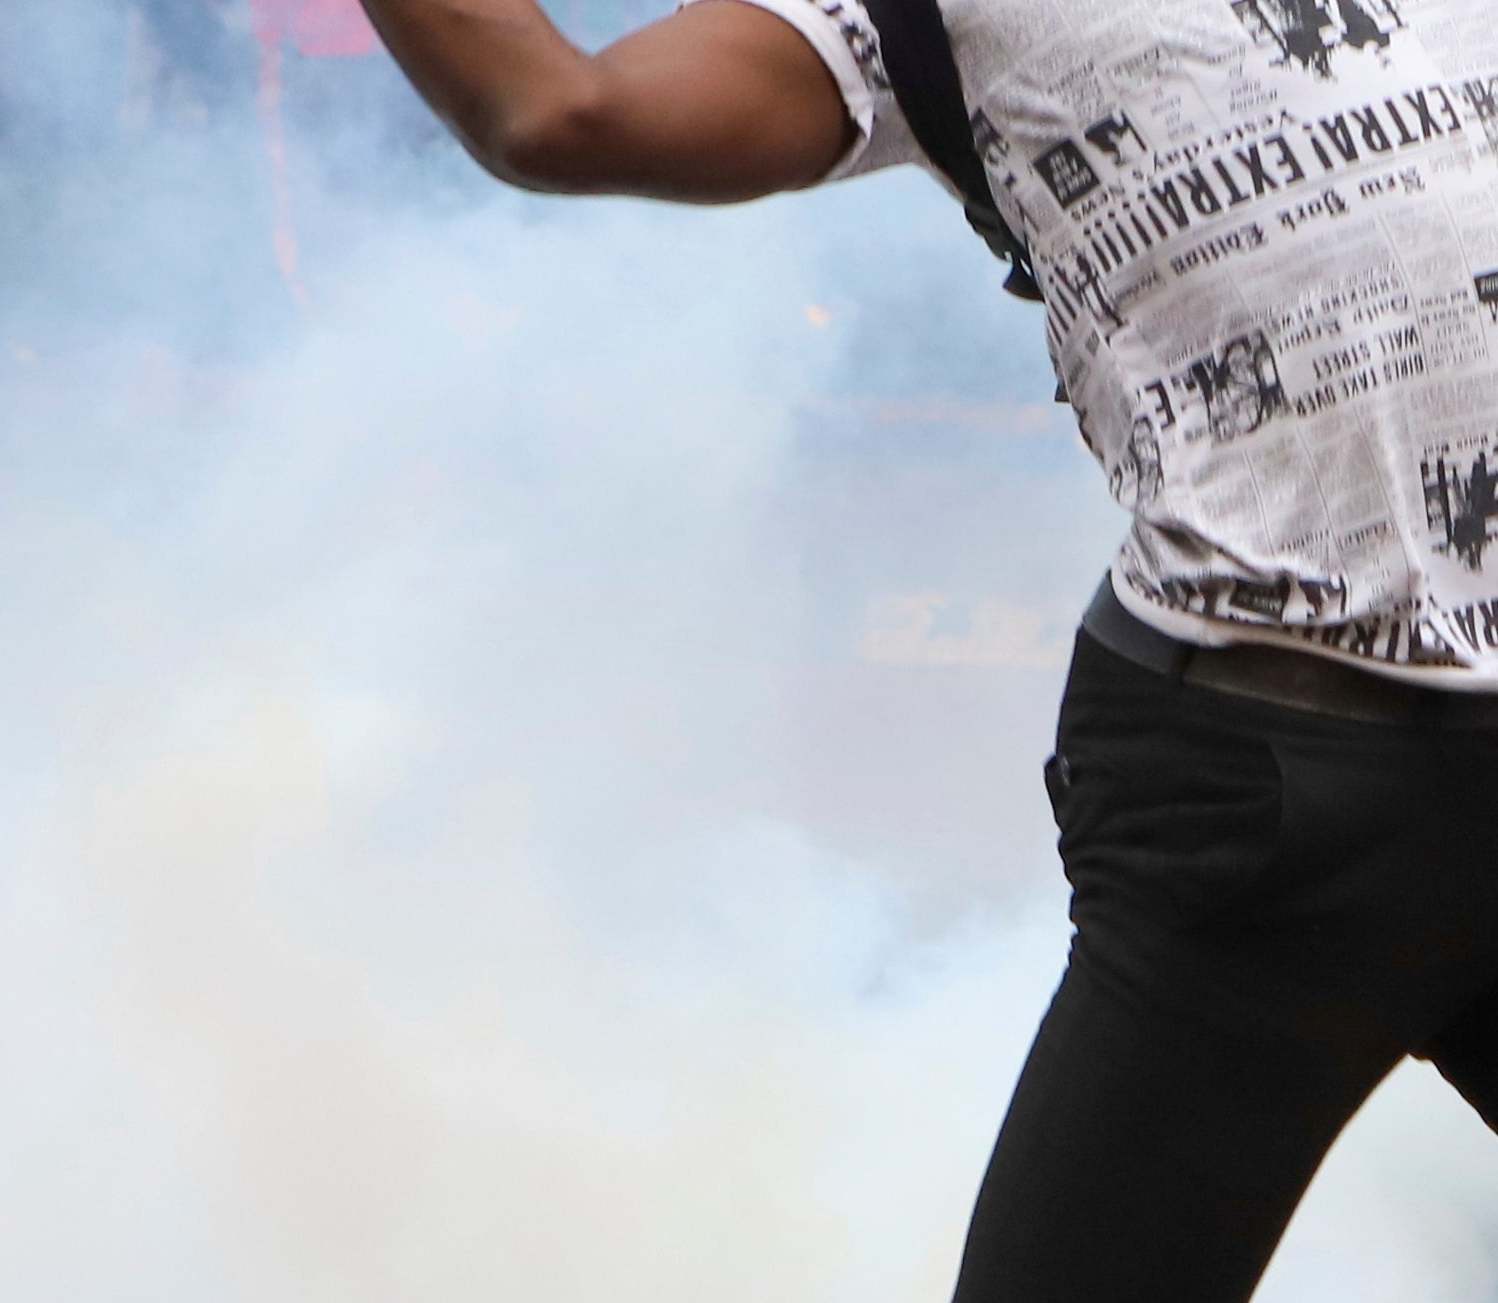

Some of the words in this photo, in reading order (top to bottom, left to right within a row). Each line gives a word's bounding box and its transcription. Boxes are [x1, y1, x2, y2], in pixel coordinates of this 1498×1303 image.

[1303, 84, 1463, 171] EXTRA!
[1377, 325, 1419, 356] WALL
[1311, 341, 1372, 381] STREET
[1343, 366, 1378, 395] TAKE
